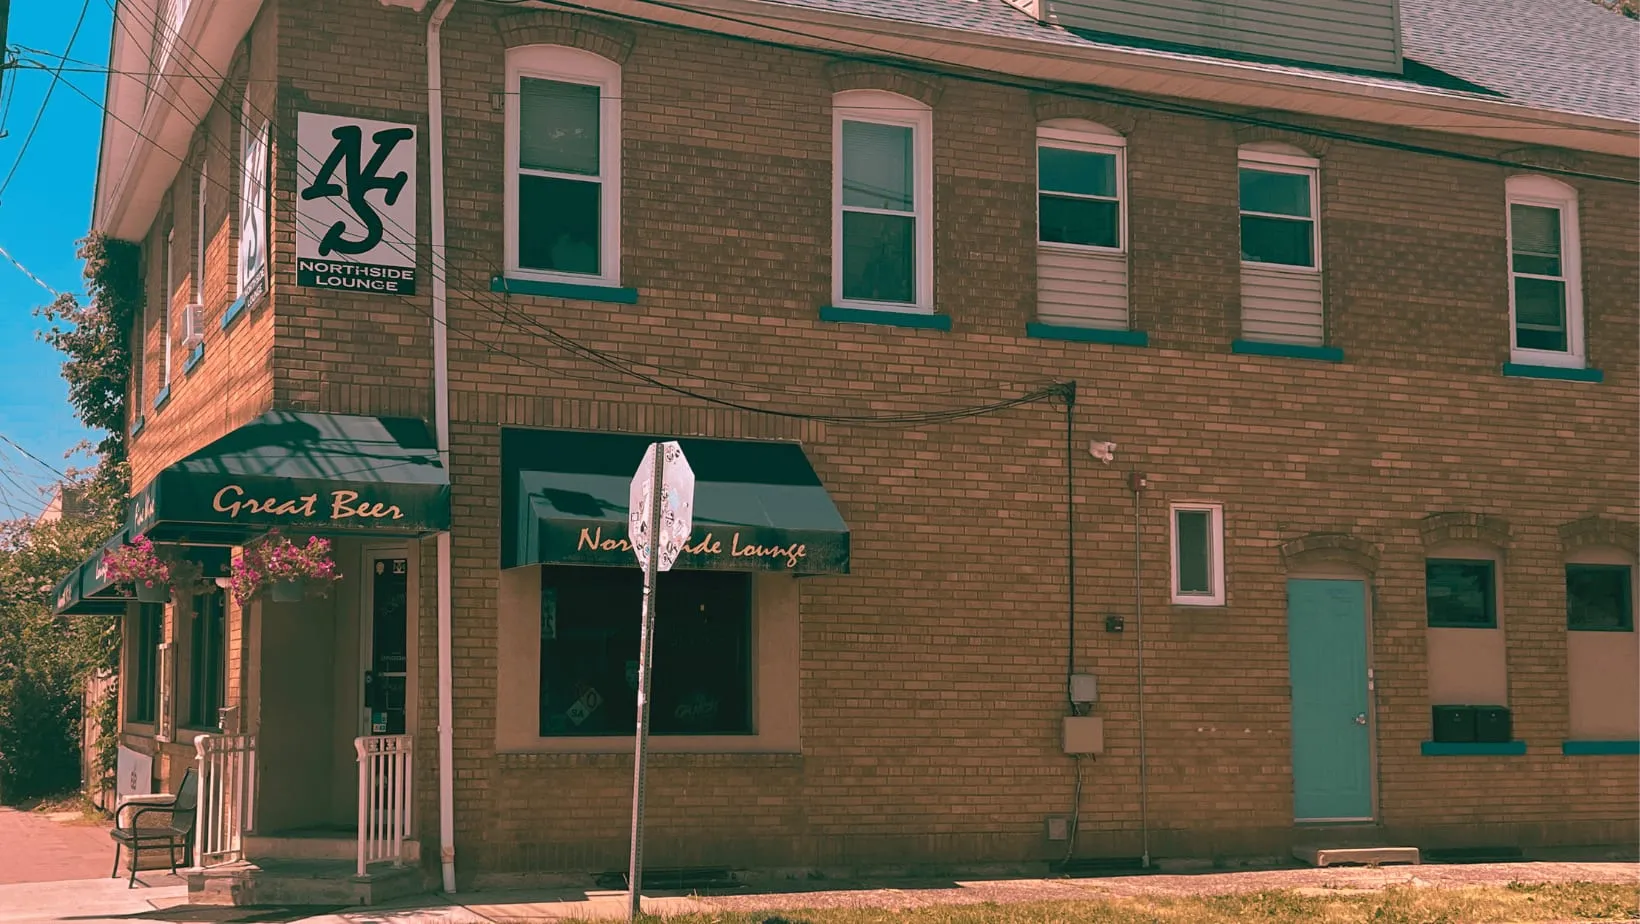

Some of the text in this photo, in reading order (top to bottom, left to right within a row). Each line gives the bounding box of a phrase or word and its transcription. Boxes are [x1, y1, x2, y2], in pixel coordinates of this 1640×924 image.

[299, 261, 414, 280] NORTHSIDE
[316, 275, 398, 291] LOUNGE
[212, 485, 404, 520] Great Beer
[577, 527, 721, 554] Noride
[731, 532, 807, 568] Lounge
